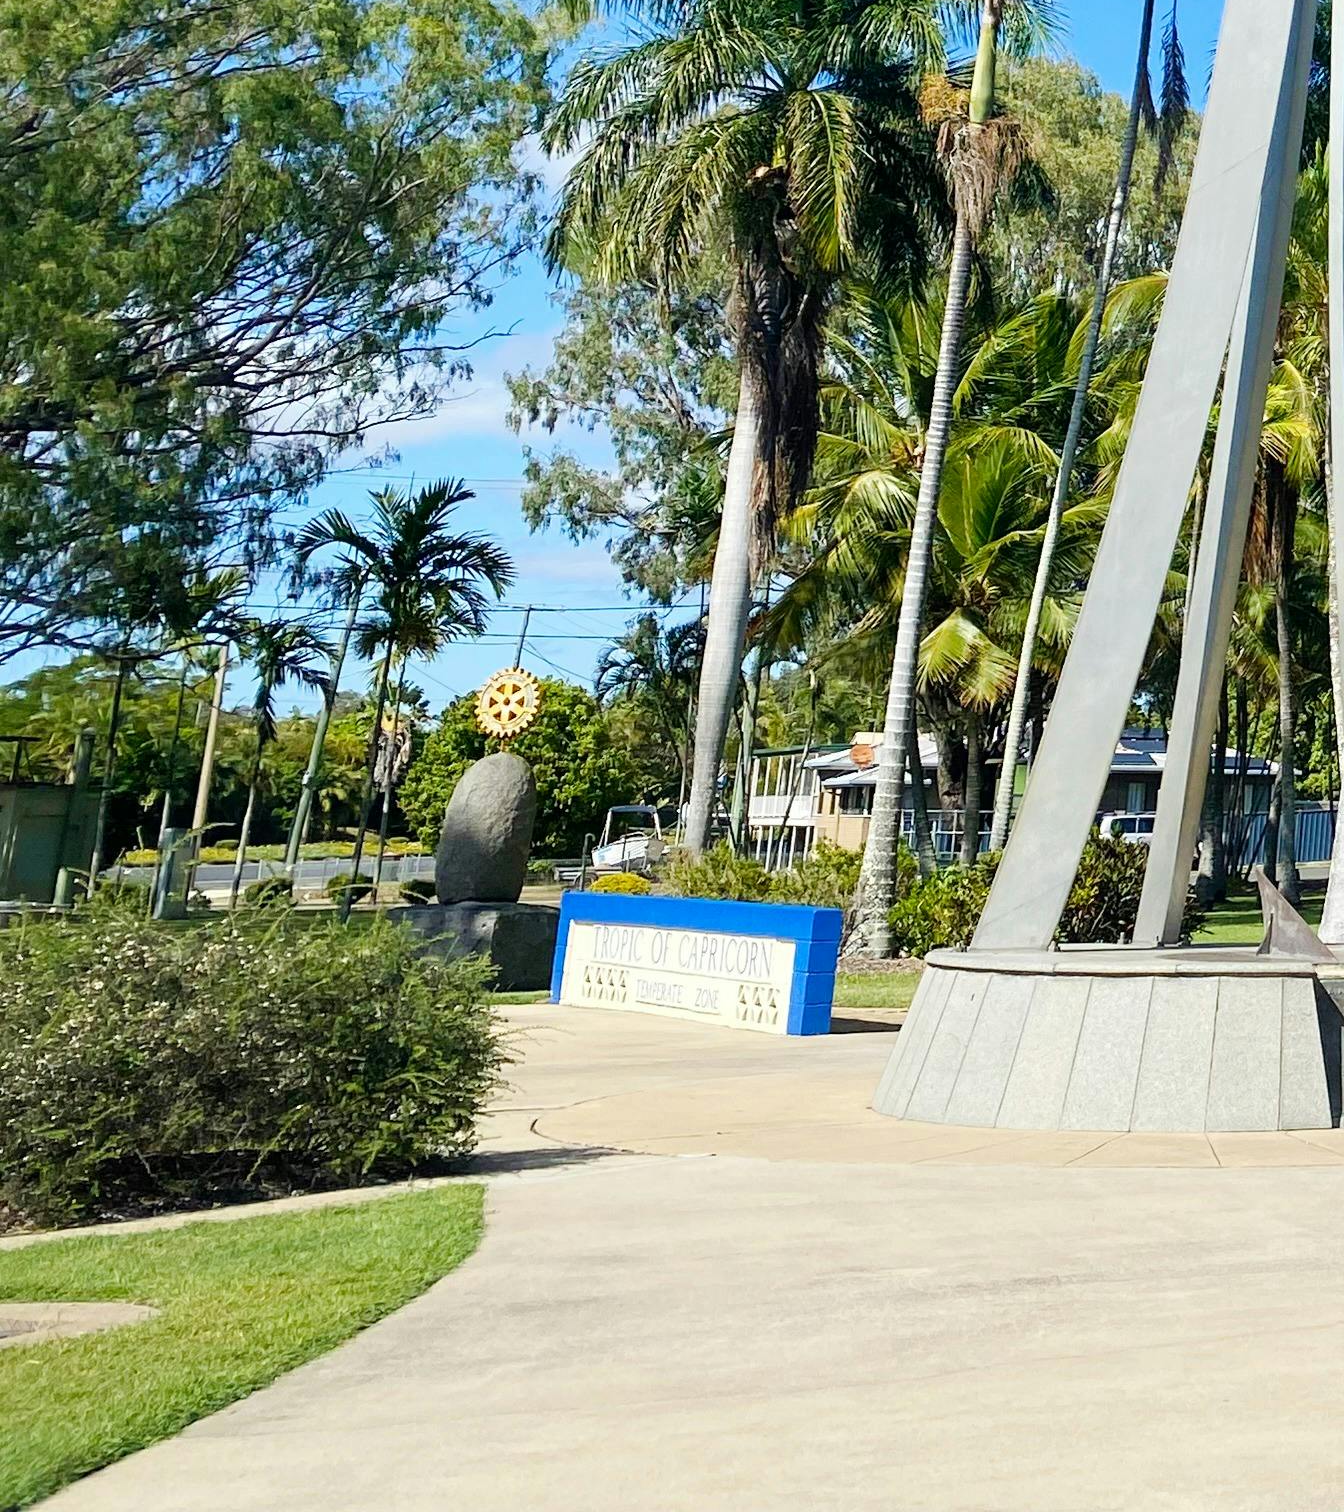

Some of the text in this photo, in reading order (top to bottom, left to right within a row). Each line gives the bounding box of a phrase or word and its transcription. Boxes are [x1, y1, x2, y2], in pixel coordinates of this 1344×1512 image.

[593, 926, 774, 978] TROPIC OF CAPRICORN
[636, 979, 720, 1010] TEMPERATE ZONE
